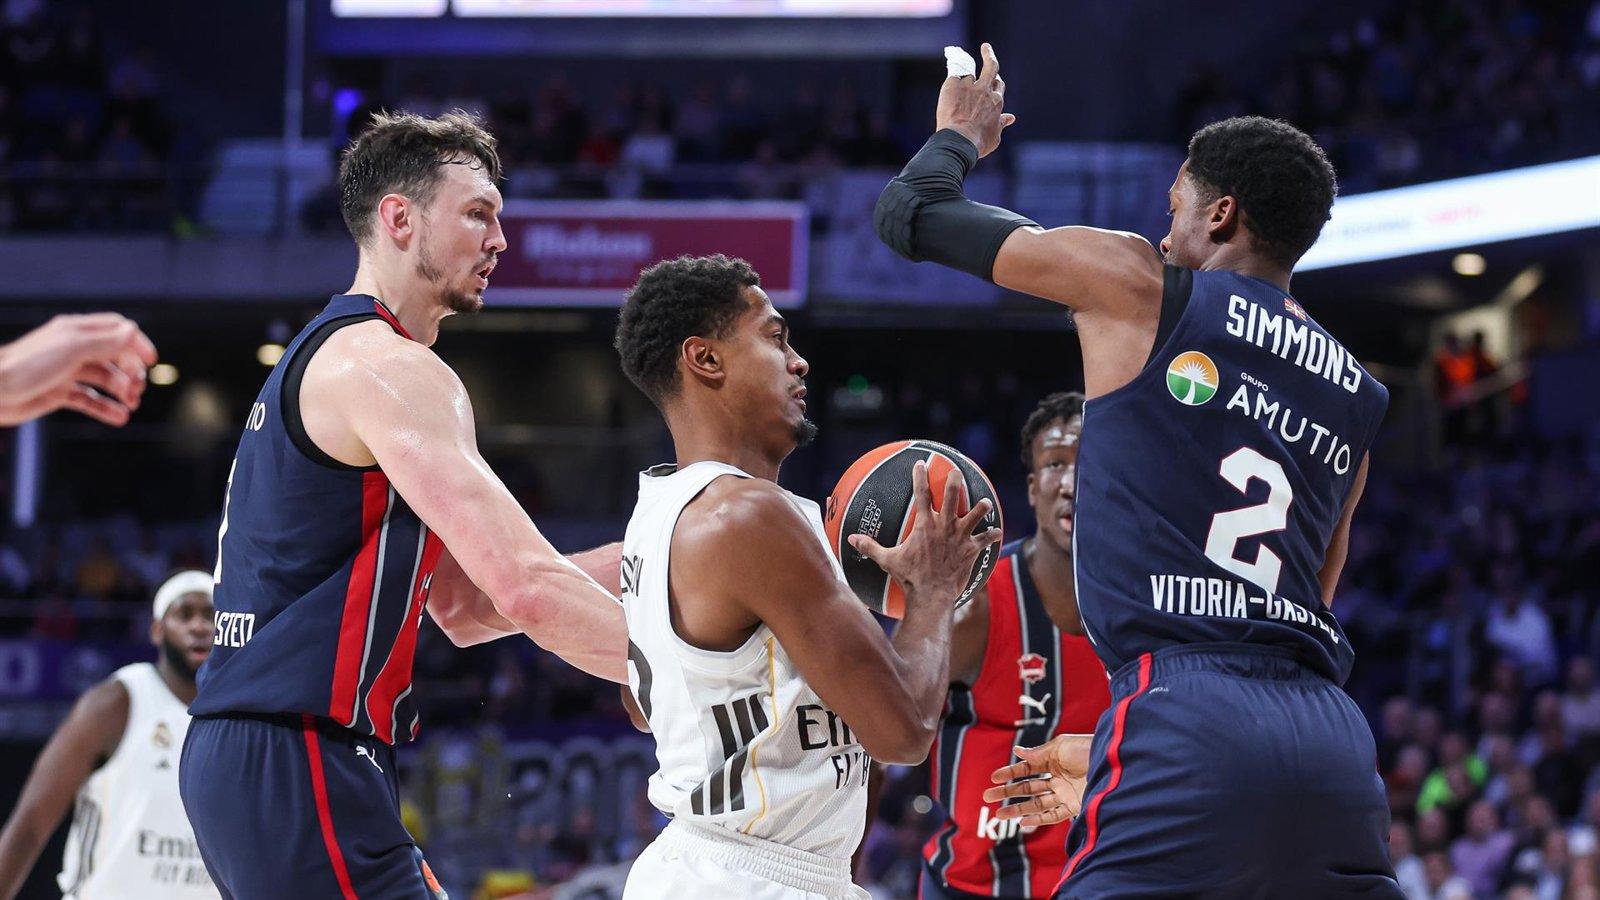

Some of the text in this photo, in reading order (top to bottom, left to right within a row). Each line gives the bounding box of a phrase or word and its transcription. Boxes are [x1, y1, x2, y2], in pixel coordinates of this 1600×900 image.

[1226, 294, 1363, 394] SIMMONS
[1240, 372, 1269, 392] GRUPO
[1226, 384, 1351, 475] AMUTIO
[1204, 446, 1293, 594] 2
